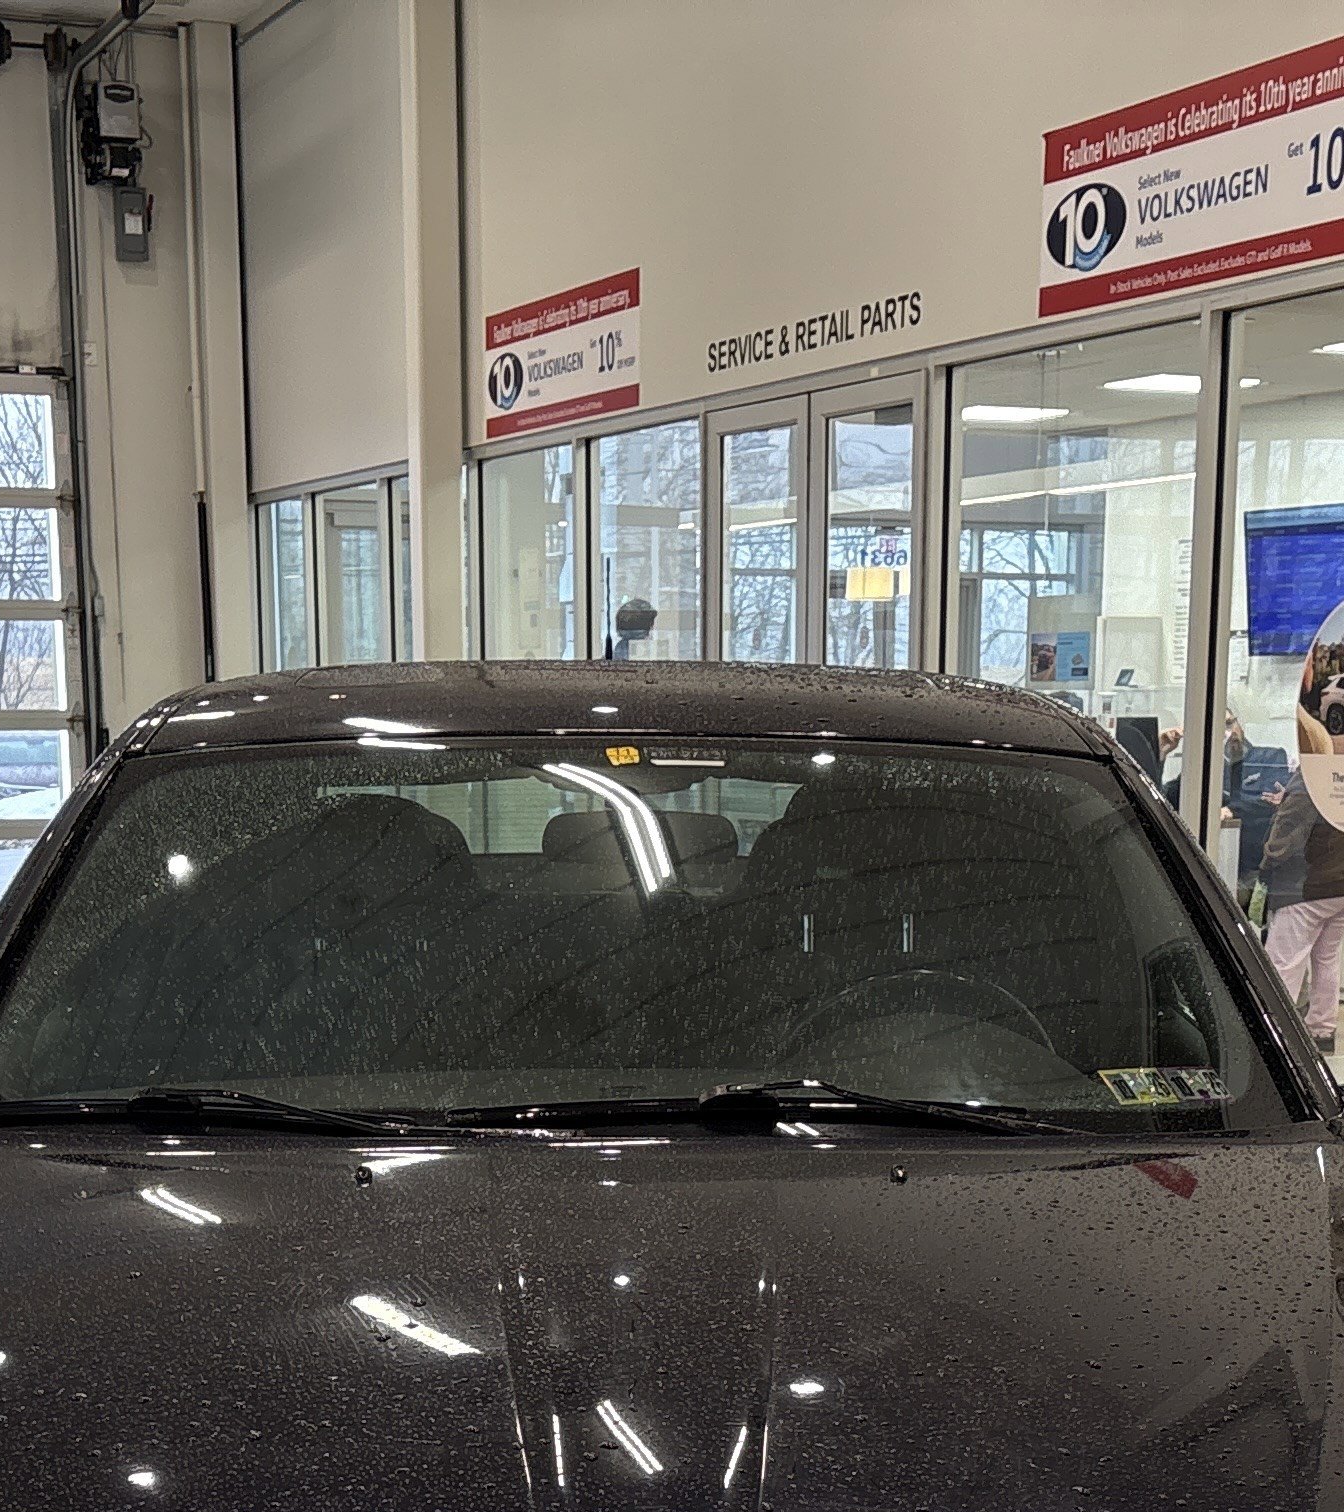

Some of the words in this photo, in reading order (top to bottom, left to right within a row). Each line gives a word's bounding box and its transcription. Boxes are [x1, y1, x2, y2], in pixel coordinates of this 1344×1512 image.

[1063, 138, 1105, 172] Faulkner
[1106, 121, 1166, 155] Volkswagen
[1167, 111, 1176, 141] is
[1177, 93, 1240, 137] Celebrating
[1258, 76, 1286, 113] 10th
[1287, 74, 1315, 112] year
[1287, 142, 1304, 158] Get
[1138, 172, 1162, 190] Select
[1163, 168, 1182, 183] New
[1138, 164, 1270, 226] VOLKSWAGEN
[1058, 187, 1108, 267] 10
[1135, 230, 1164, 249] Models
[707, 329, 774, 373] SERVICE
[779, 325, 790, 356] &
[795, 309, 855, 353] RETAIL
[860, 291, 921, 337] PARTS
[492, 356, 515, 407] 10
[527, 351, 584, 383] VOLKSWAGEN
[1332, 772, 1344, 783] The
